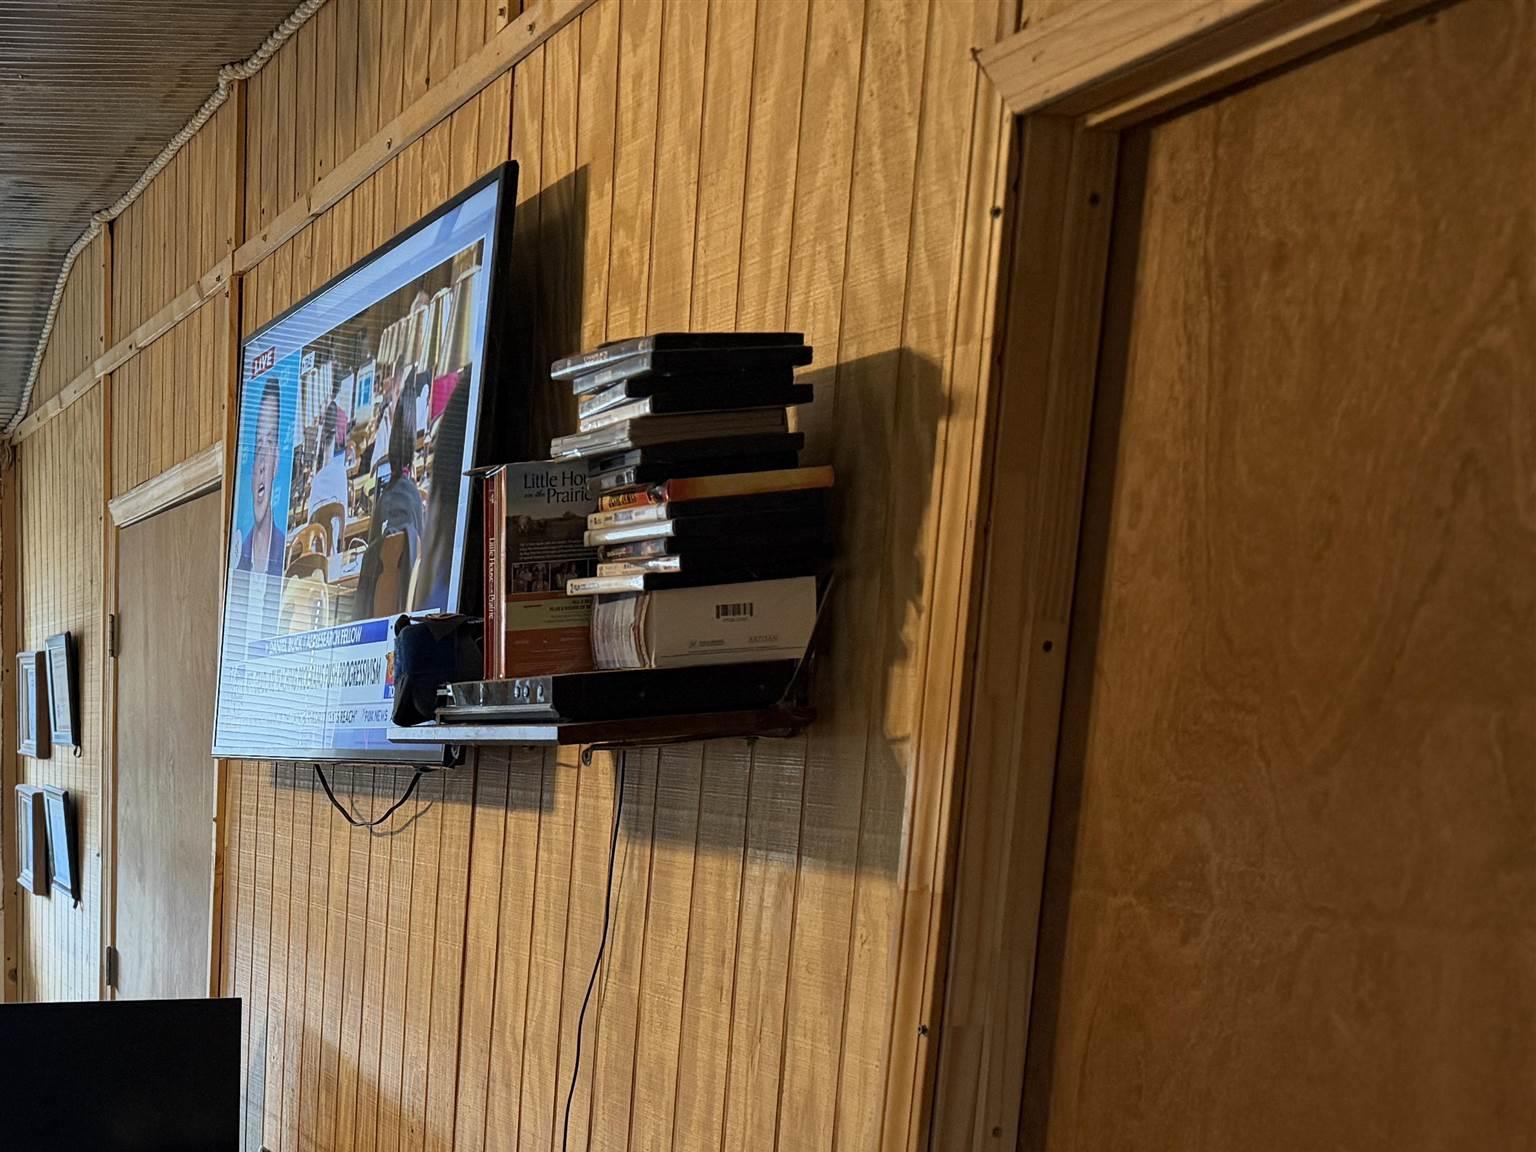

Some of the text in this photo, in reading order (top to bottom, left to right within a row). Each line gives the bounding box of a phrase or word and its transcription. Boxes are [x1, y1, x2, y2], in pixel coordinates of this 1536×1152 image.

[253, 350, 274, 377] LIVE
[524, 471, 558, 489] Little
[341, 626, 363, 643] FELLOW
[339, 657, 382, 688] PROGRESSIVISM
